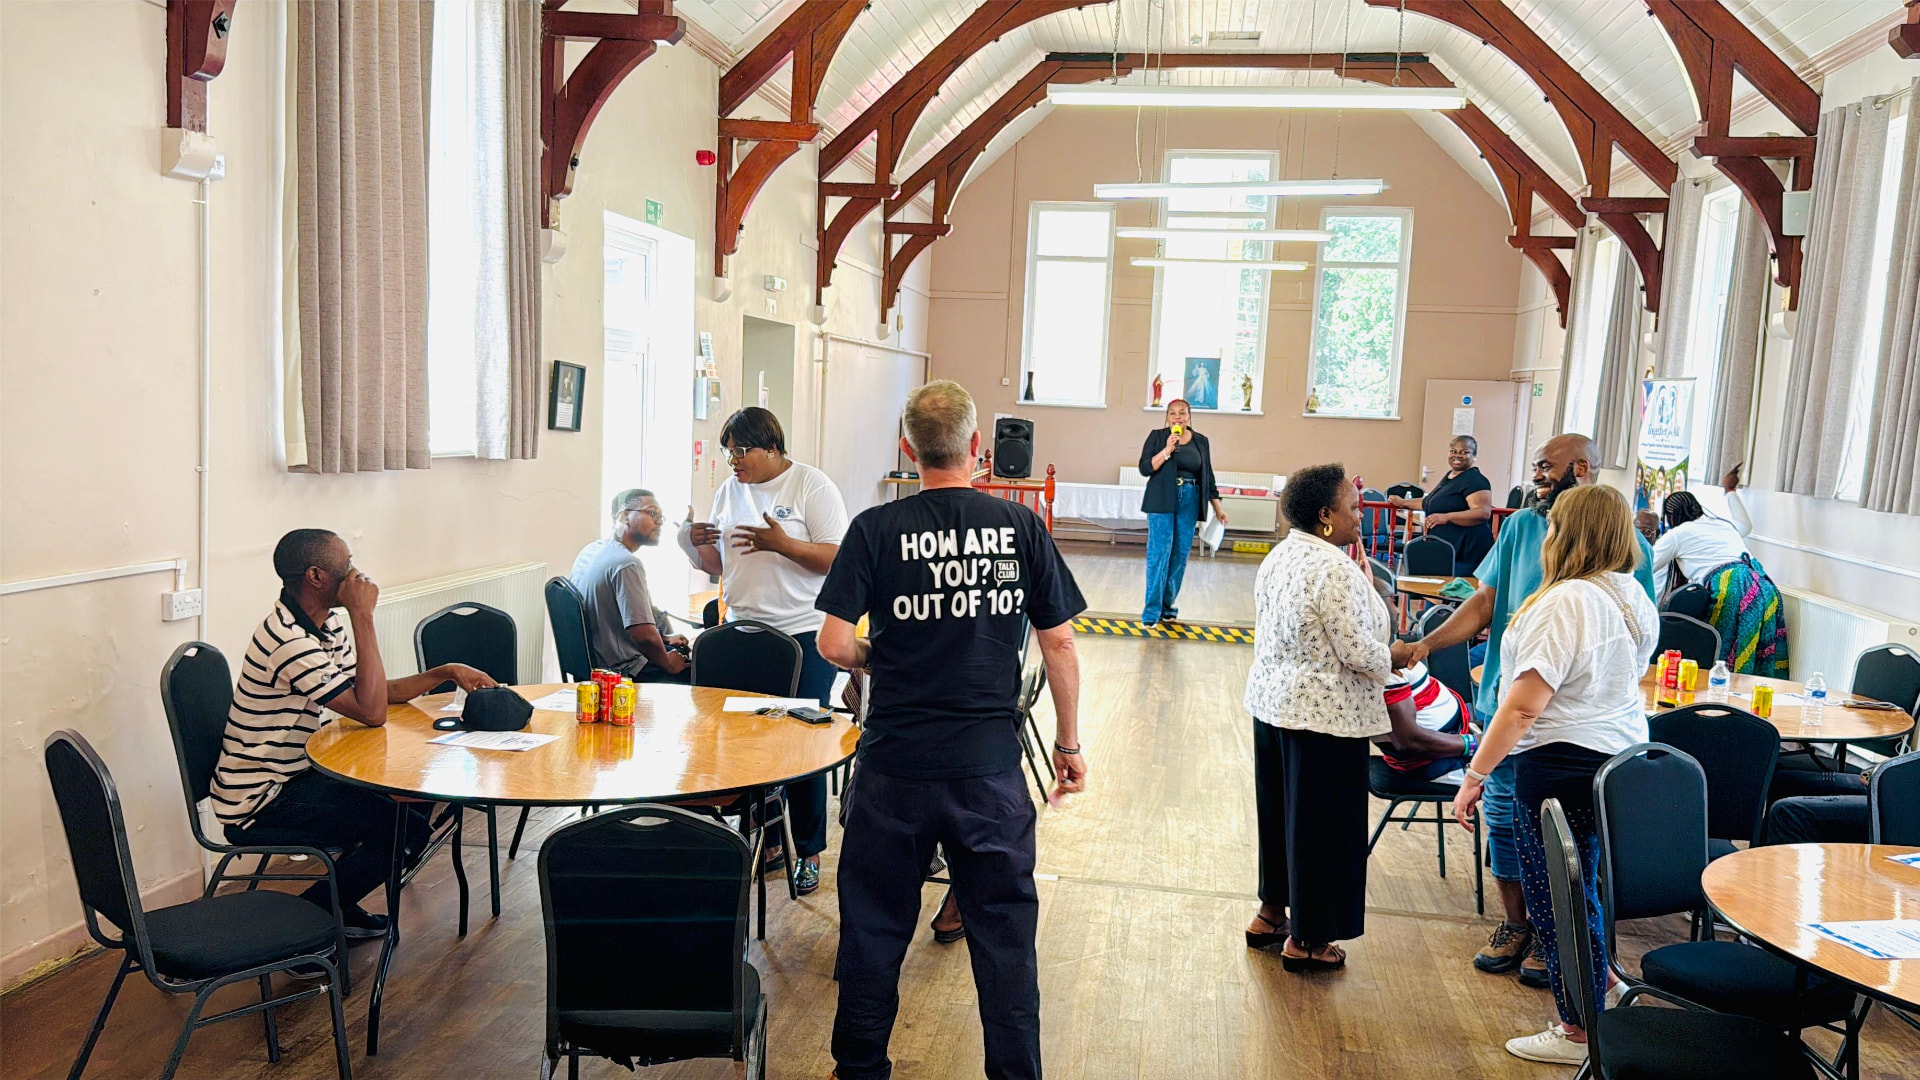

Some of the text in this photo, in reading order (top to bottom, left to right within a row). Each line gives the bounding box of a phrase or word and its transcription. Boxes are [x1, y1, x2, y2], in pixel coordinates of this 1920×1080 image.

[901, 527, 1016, 561] HOW ARE
[928, 558, 992, 589] YOU?
[997, 562, 1015, 571] TALK
[997, 570, 1016, 579] CLUB
[893, 588, 1025, 621] OUT OF 10?
